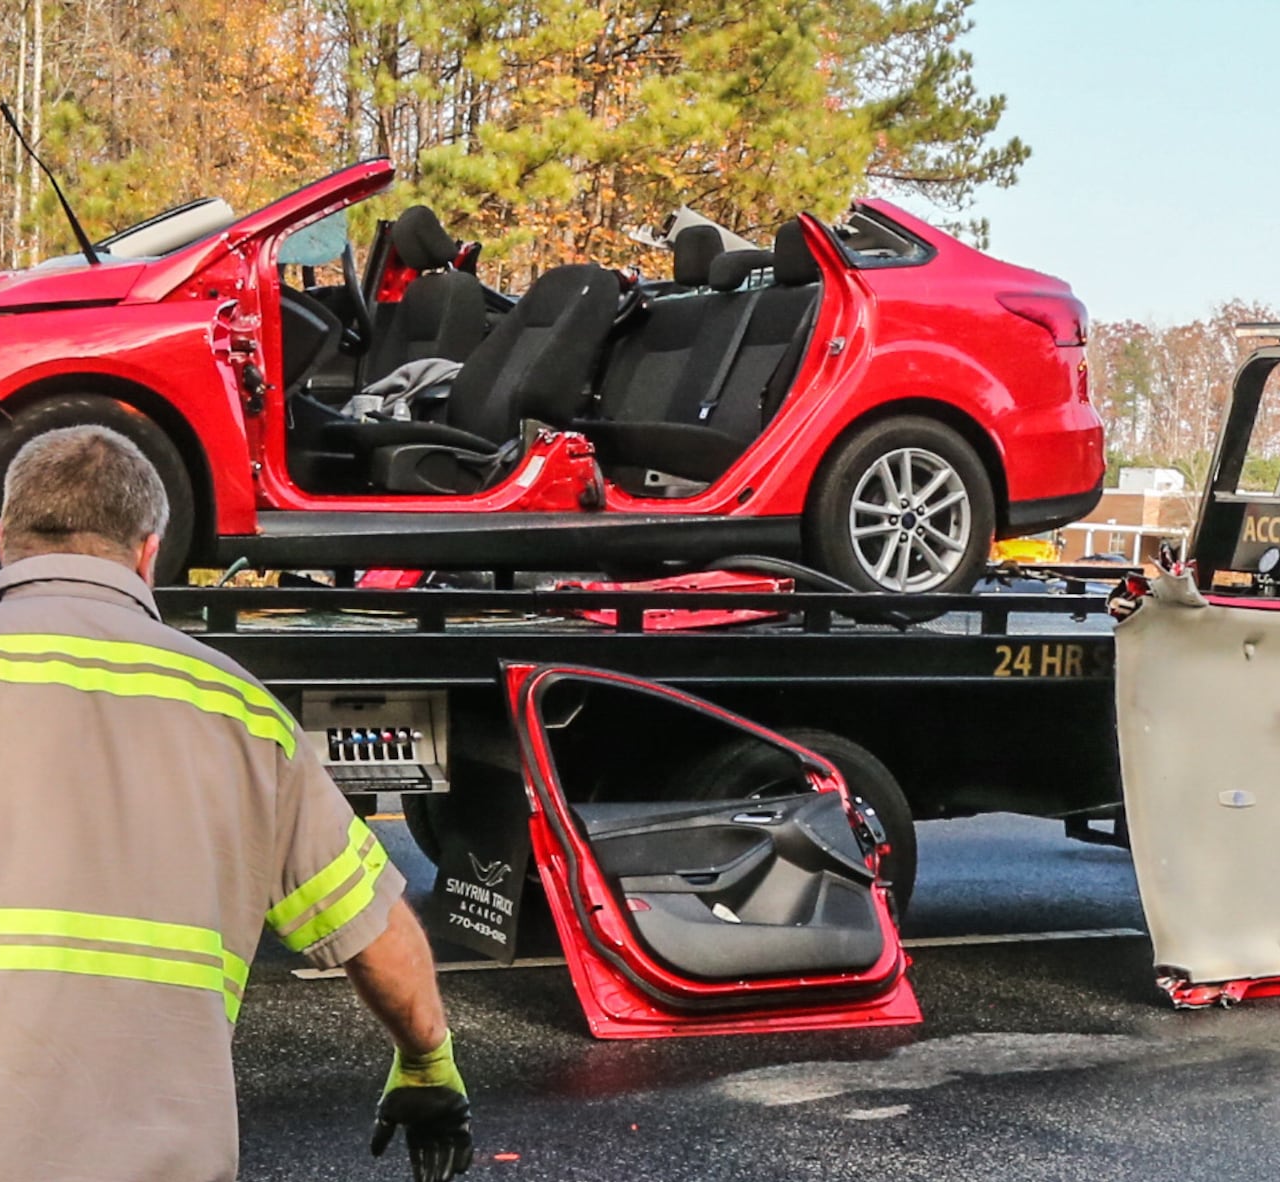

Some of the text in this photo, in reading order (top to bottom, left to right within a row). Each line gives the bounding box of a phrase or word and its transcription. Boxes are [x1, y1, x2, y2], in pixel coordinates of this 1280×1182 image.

[993, 644, 1032, 677] 24
[1040, 644, 1083, 676] HR
[446, 878, 514, 917] SMYRNA TRUCK
[468, 903, 503, 925] CARGO
